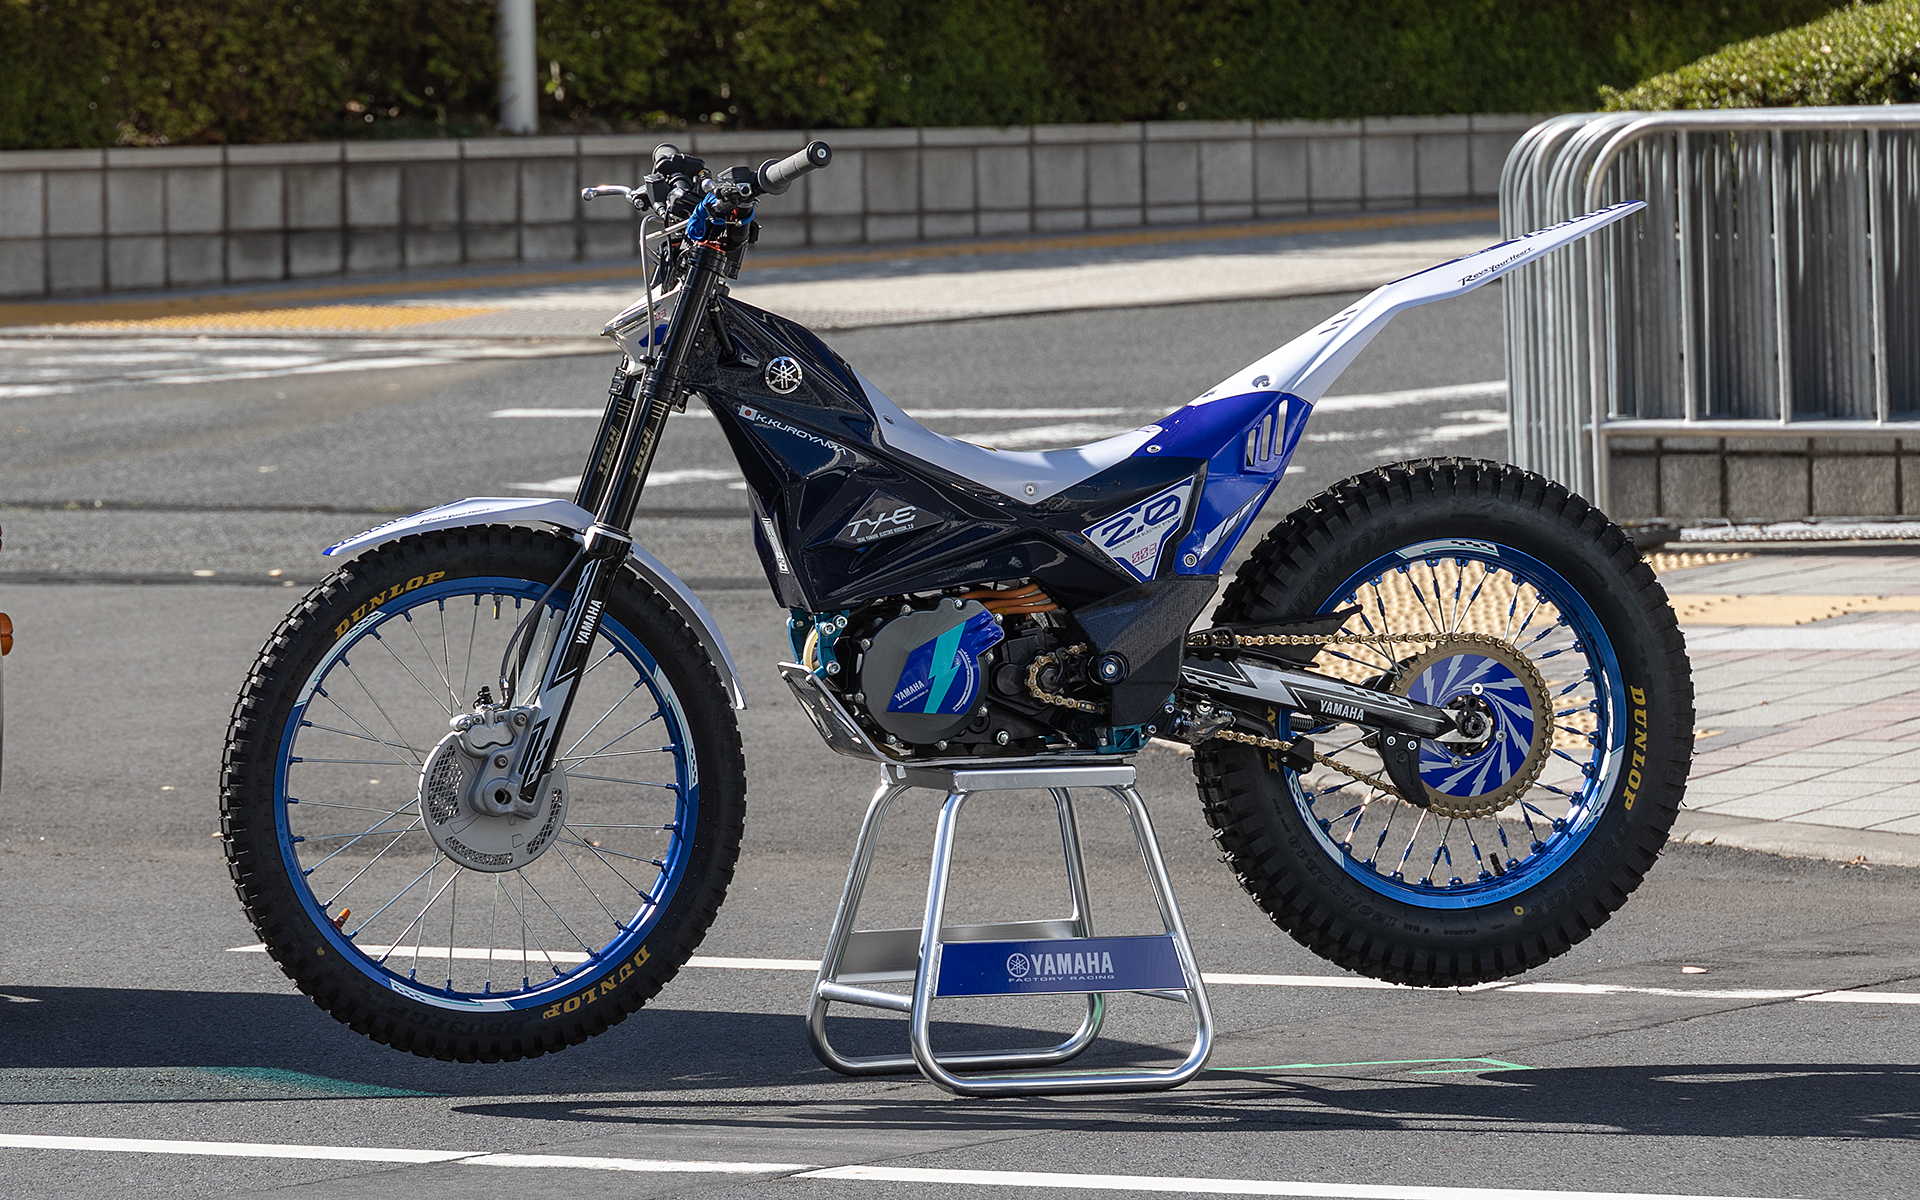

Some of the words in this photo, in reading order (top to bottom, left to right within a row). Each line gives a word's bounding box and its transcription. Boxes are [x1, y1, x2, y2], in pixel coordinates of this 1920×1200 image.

[756, 414, 847, 456] K.KUROYAMA
[1100, 494, 1181, 548] 2.0
[334, 570, 446, 640] DUNLOP
[575, 600, 602, 645] YAMAHA
[894, 680, 925, 702] YAMAHA
[1320, 699, 1364, 721] YAMAHA
[1623, 685, 1647, 811] DUNLOP
[542, 944, 651, 1020] DUNLOP
[1030, 951, 1114, 976] YAMAHA
